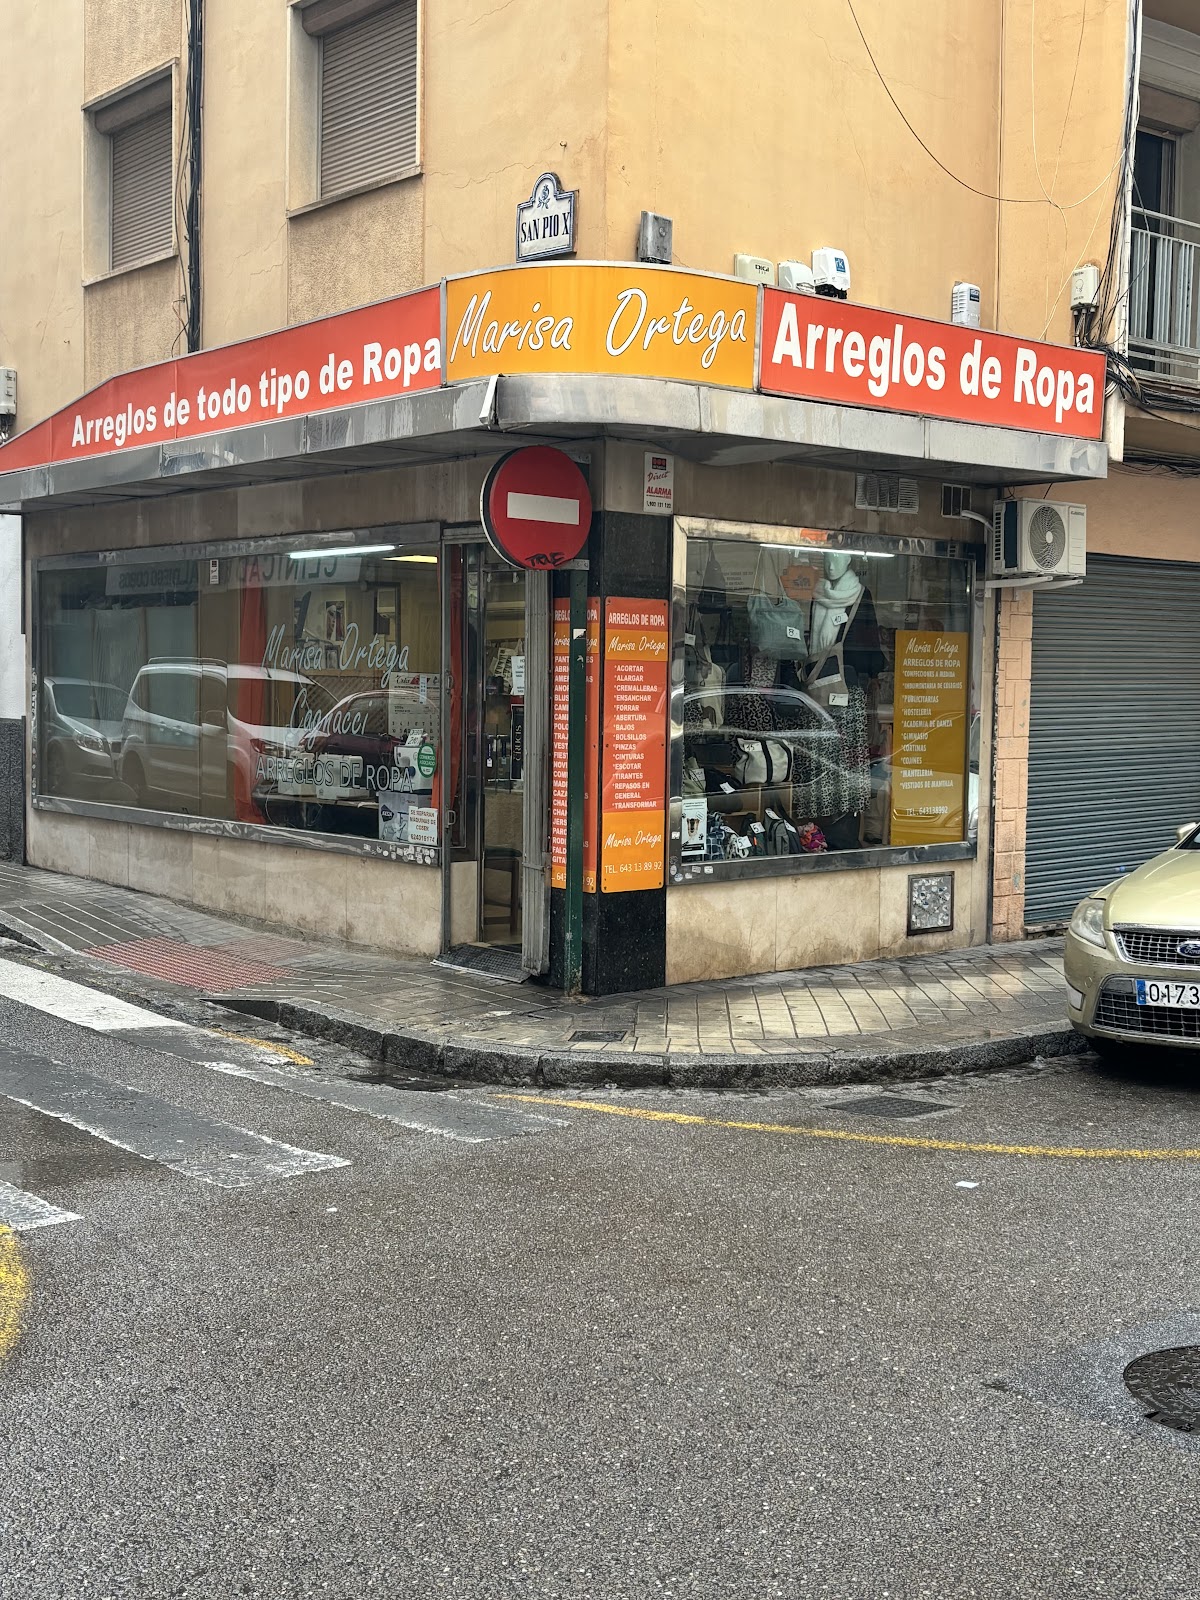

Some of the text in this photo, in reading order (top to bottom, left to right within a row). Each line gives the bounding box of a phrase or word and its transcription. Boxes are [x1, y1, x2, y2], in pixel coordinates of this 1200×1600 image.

[520, 211, 571, 243] SAN PIO X
[449, 287, 747, 369] Marisa Ortega
[771, 302, 1095, 423] Arreglos de Ropa
[71, 336, 441, 448] Arreglos de todo tipo de Ropa
[647, 471, 670, 482] Direct
[646, 486, 672, 496] ALARMA
[608, 612, 665, 626] ARREGLOS DE ROPA
[259, 622, 410, 688] Marisa Ortega
[607, 636, 666, 656] Marisa Ortega
[905, 637, 959, 658] Marisa Ortega
[903, 658, 934, 667] ARREGLOS
[944, 660, 960, 668] ROPA
[255, 755, 414, 793] ARREGLOS DE ROPA
[604, 830, 662, 849] Marisa Ortega
[619, 863, 632, 873] 643
[634, 863, 642, 872] 13
[643, 862, 652, 871] 89
[653, 861, 662, 870] 92
[1148, 983, 1199, 1005] 0173
